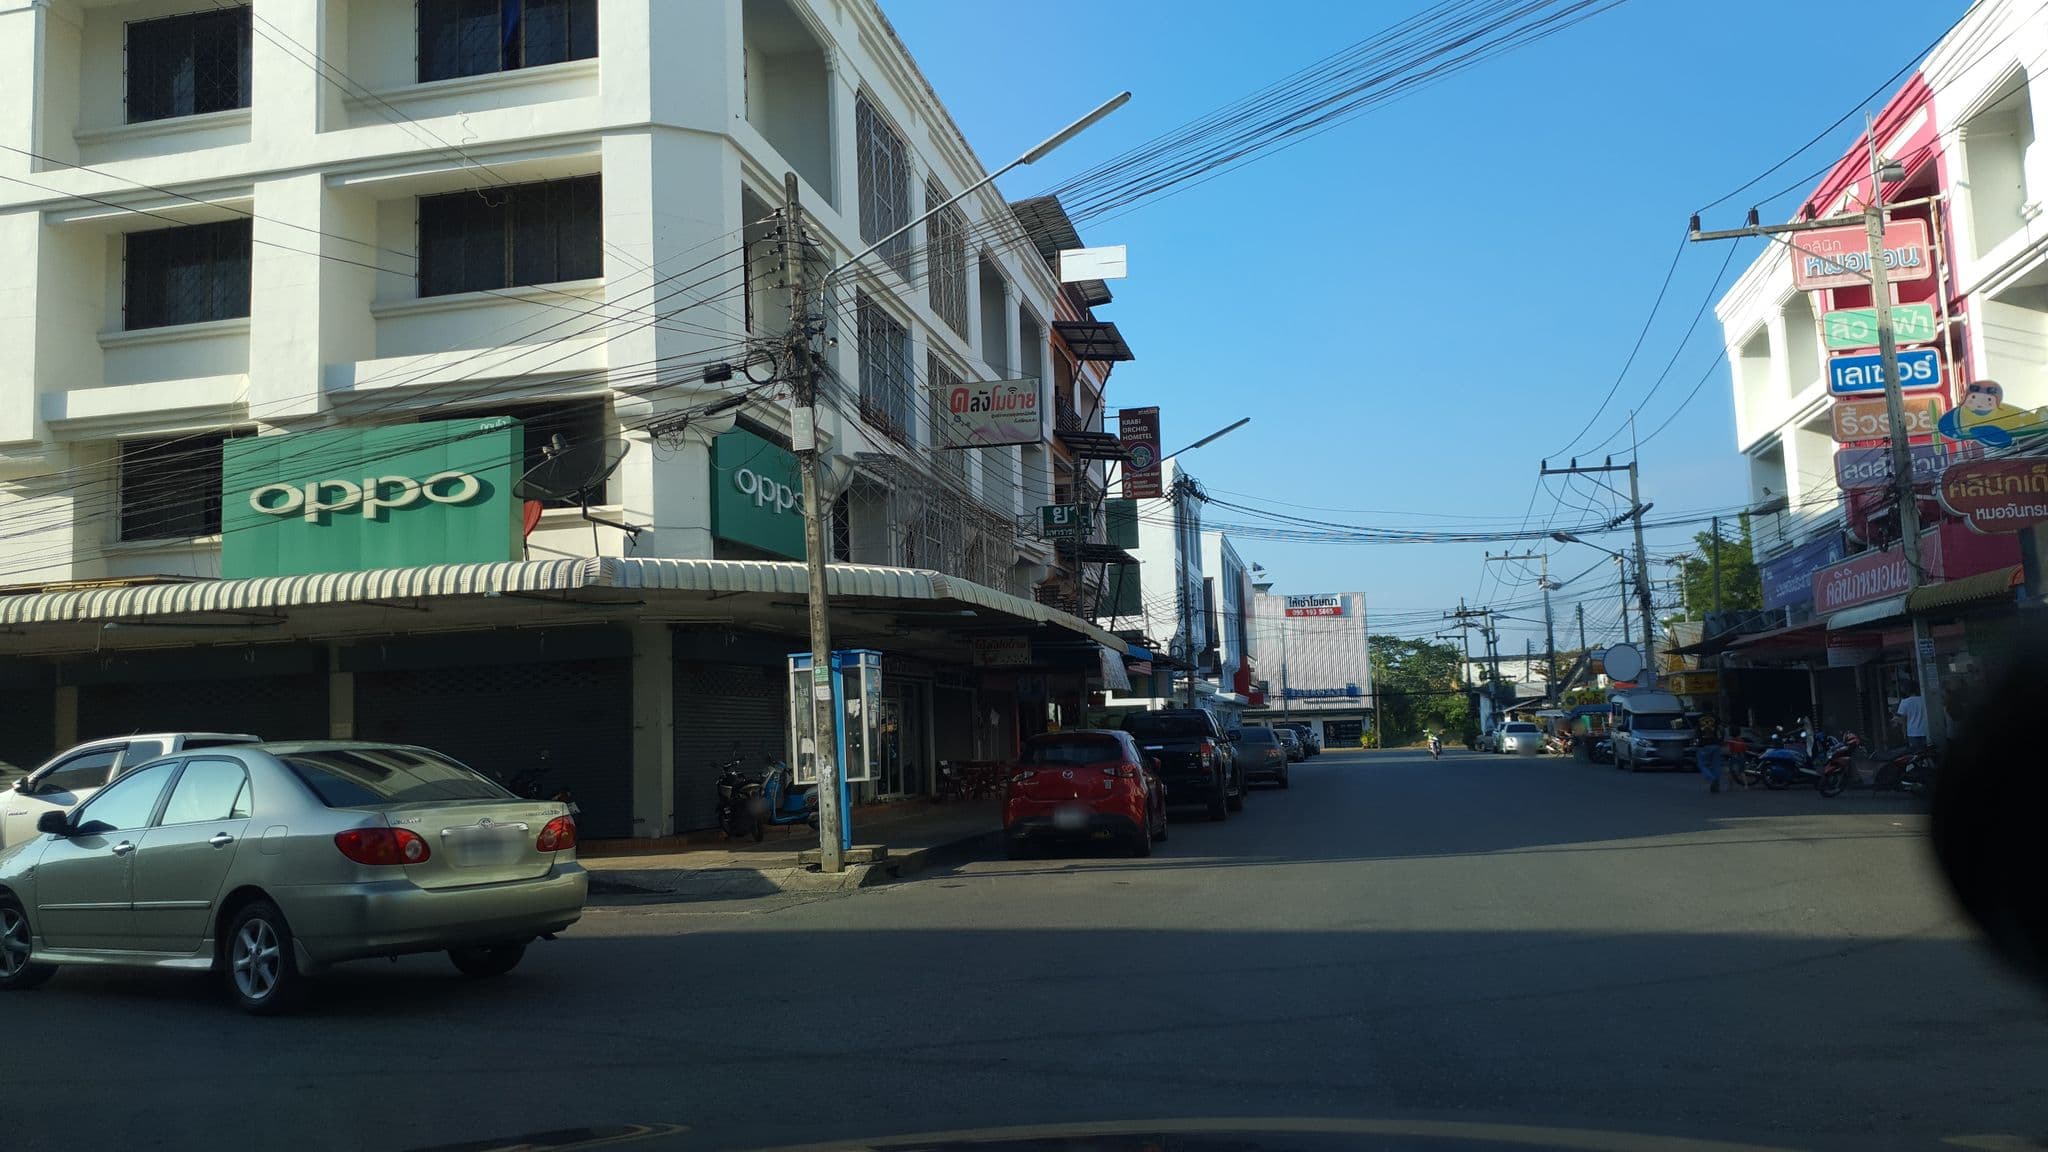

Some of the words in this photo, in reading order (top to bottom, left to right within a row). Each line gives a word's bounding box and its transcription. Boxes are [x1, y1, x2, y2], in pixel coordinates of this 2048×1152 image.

[1831, 317, 1869, 340] สิว
[1836, 354, 1934, 386] เลเซอร์
[1122, 426, 1149, 434] ORCHID
[1122, 433, 1153, 441] HOMETEL
[1826, 561, 1910, 606] คลินิกหมอแอ
[1287, 595, 1338, 608] ให้เช่าโฆษณา
